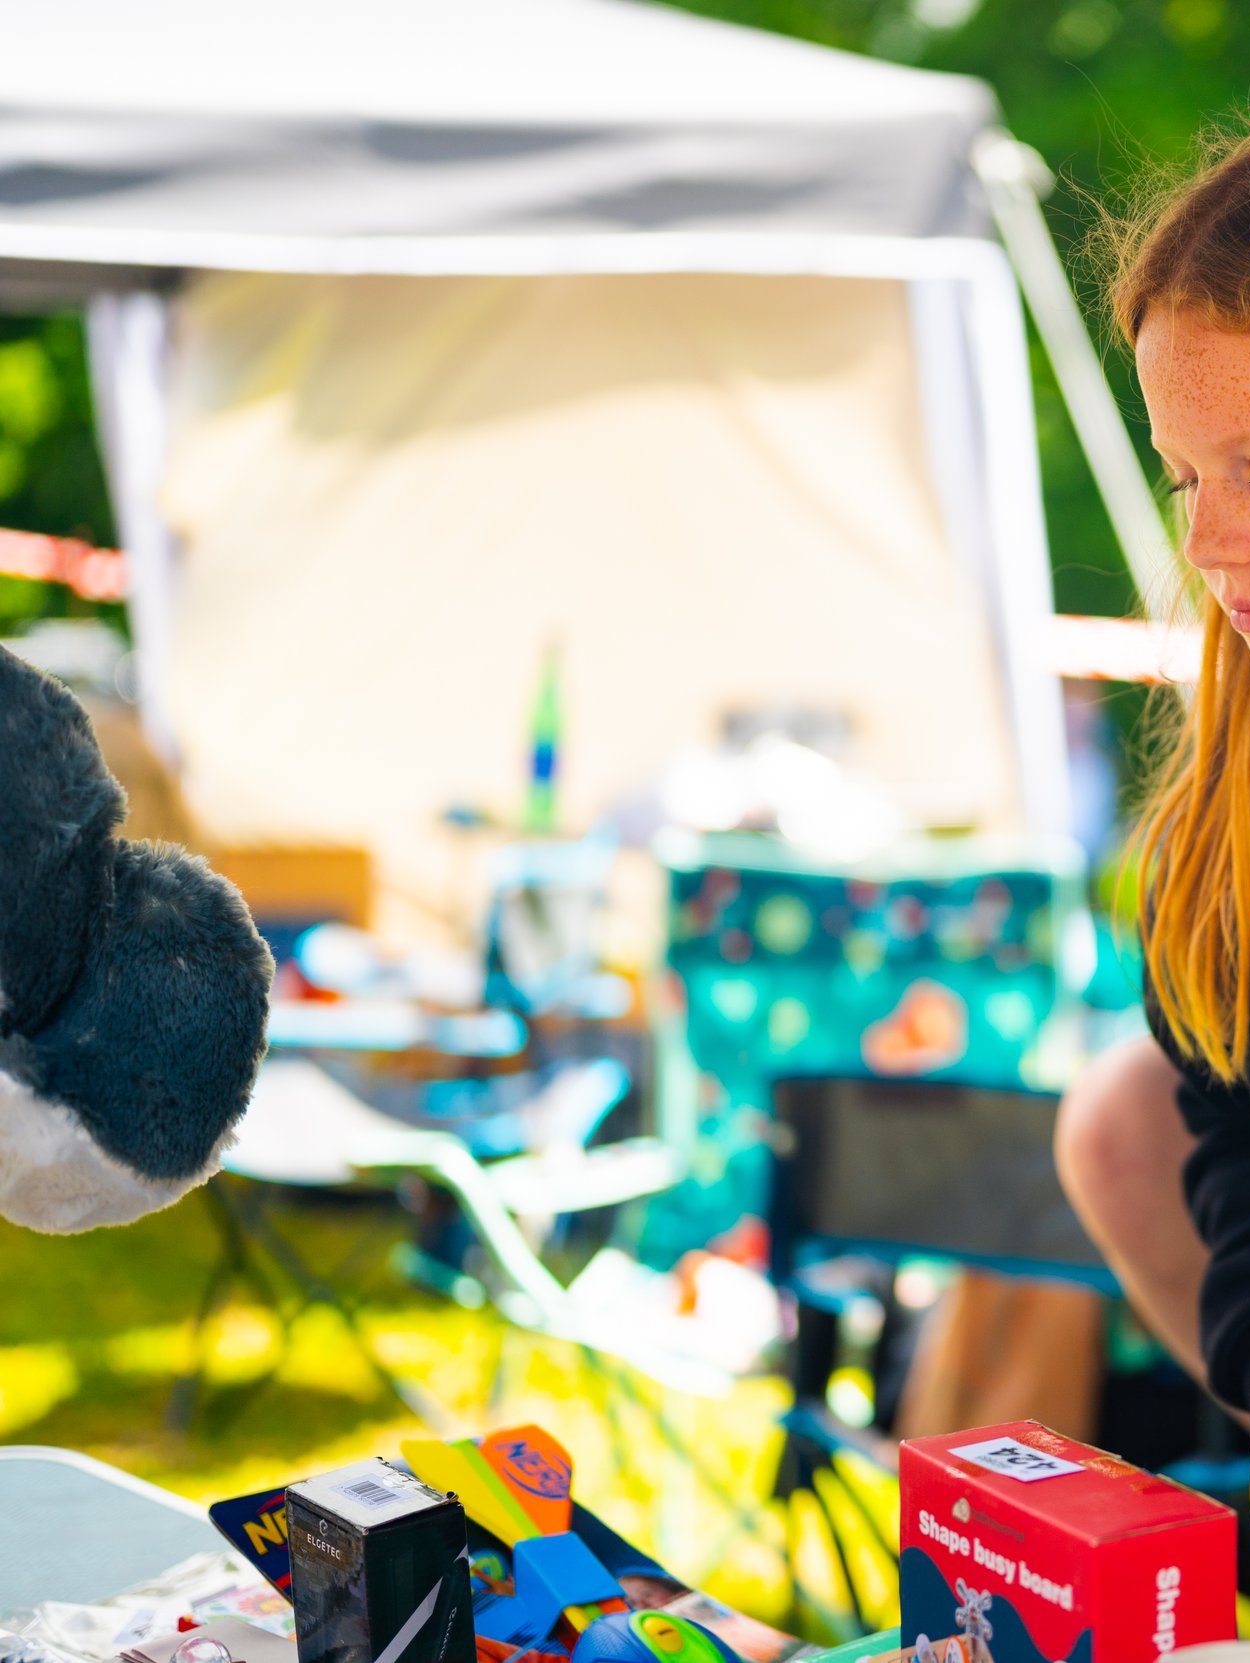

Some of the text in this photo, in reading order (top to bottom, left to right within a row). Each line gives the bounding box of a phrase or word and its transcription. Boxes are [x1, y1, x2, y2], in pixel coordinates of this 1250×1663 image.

[988, 1446, 1057, 1470] 424
[918, 1509, 970, 1556] Shape
[973, 1537, 1016, 1584] busy
[1018, 1559, 1075, 1612] board
[1151, 1565, 1182, 1661] Shap
